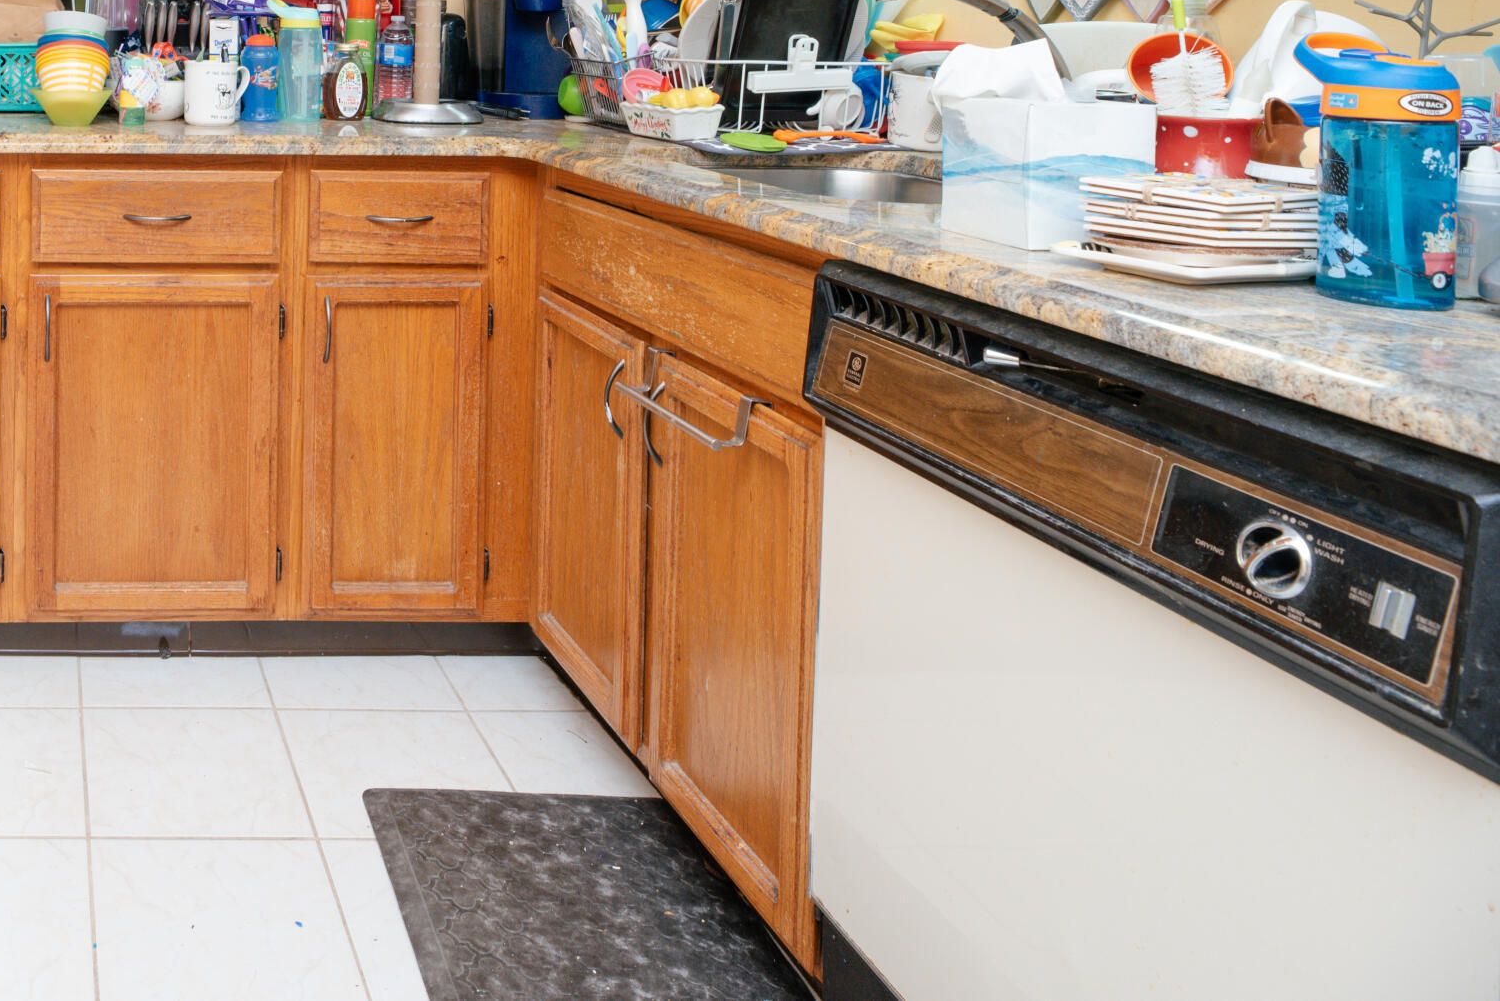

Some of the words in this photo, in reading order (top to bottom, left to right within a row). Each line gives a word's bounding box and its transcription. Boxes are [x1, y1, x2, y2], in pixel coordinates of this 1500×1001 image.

[1426, 101, 1445, 109] BACK
[1268, 508, 1281, 517] OFF
[1297, 519, 1309, 529] ON
[1194, 537, 1226, 557] DRYING
[1316, 538, 1346, 555] LIGHT
[1314, 547, 1345, 566] WASH
[1221, 575, 1246, 592] RINSE
[1252, 591, 1275, 606] ONLY
